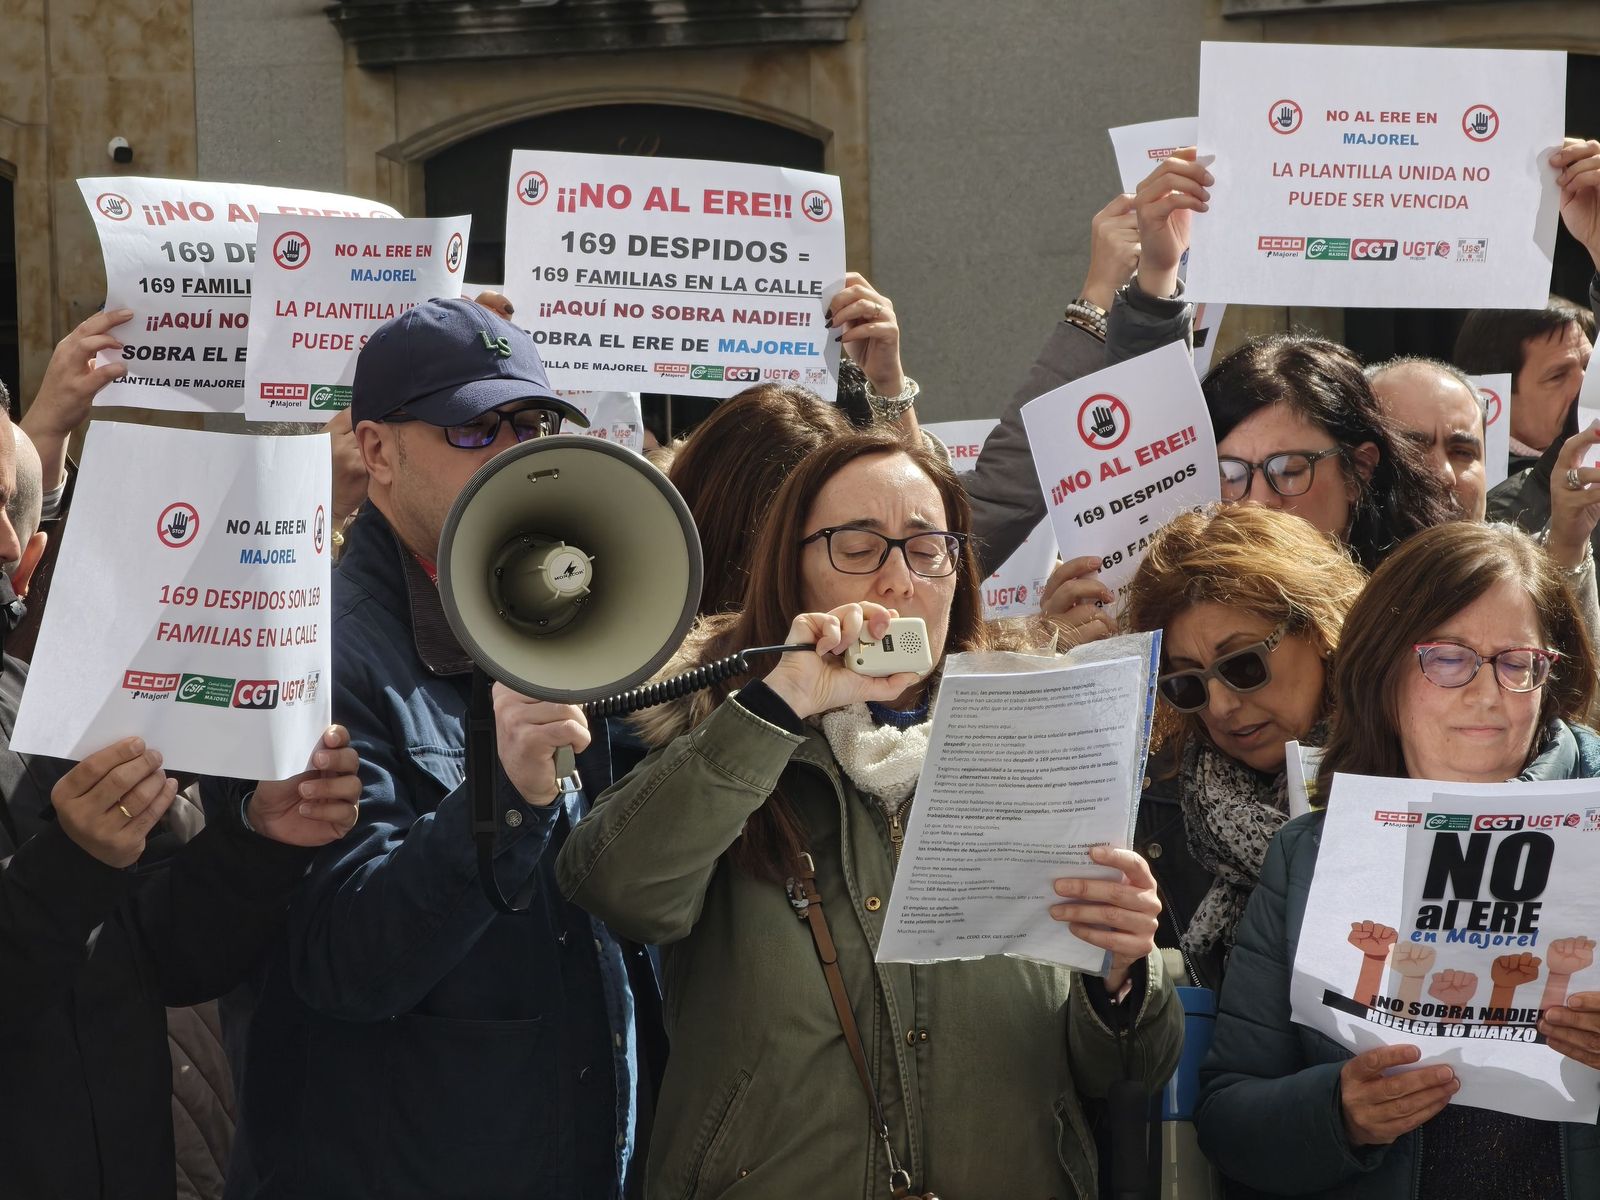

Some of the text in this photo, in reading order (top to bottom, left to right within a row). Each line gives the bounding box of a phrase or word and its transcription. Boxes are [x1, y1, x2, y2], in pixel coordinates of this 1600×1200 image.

[1326, 109, 1438, 124] NO AL ERE EN
[1343, 132, 1419, 146] MAJOREL
[1272, 162, 1490, 182] LA PLANTILLA UNIDA NO
[557, 182, 792, 218] ¡¡NO AL ERE!!
[1289, 191, 1469, 210] PUEDE SER VENCIDA
[142, 201, 215, 226] ¡¡NO
[161, 241, 215, 263] 169
[335, 244, 432, 257] NO AL ERE EN
[561, 231, 809, 264] 169 DESPIDOS =
[1262, 239, 1301, 248] CCOO
[1355, 242, 1396, 258] CGT
[1403, 241, 1435, 256] UGT
[350, 269, 417, 282] MAJOREL
[531, 266, 822, 295] 169 FAMILIAS EN LA CALLE
[139, 277, 175, 294] 169
[275, 300, 298, 317] LA
[304, 301, 394, 320] PLANTILLA
[539, 298, 811, 327] ¡¡AQUÍ NO SOBRA NADIE!!
[146, 309, 249, 332] ¡¡AQUÍ NO
[292, 332, 354, 350] PUEDE
[524, 330, 820, 356] OBRA EL ERE DE MAJOREL
[121, 345, 196, 362] SOBRA
[203, 347, 228, 362] EL
[574, 362, 589, 370] DE
[592, 363, 648, 372] MAJOREL
[727, 368, 758, 381] CGT
[764, 369, 789, 379] UGT
[175, 379, 190, 387] DE
[264, 386, 305, 397] CCOO
[1098, 424, 1114, 434] STOP
[1051, 426, 1197, 506] ¡¡NO AL ERE!!
[1073, 463, 1197, 528] 169 DESPIDOS
[226, 519, 306, 535] NO AL ERE EN
[1138, 515, 1149, 525] =
[239, 549, 296, 564] MAJOREL
[159, 584, 320, 610] 169 DESPIDOS SON 169
[987, 587, 1016, 607] UGT
[156, 622, 317, 647] FAMILIAS EN LA CALLE
[127, 675, 175, 687] CCOO
[282, 679, 300, 701] UGT
[141, 693, 170, 701] Majorel
[238, 685, 277, 705] CGT
[1479, 817, 1522, 829] CGT
[1527, 815, 1564, 827] UGT
[1422, 831, 1555, 902] NO
[1416, 900, 1543, 933] al ERE
[1411, 927, 1539, 948] en Majorel
[1370, 995, 1404, 1013] ¡NO
[1408, 1001, 1474, 1020] SOBRA
[1366, 1009, 1538, 1043] HUELGA 10 MARZO
